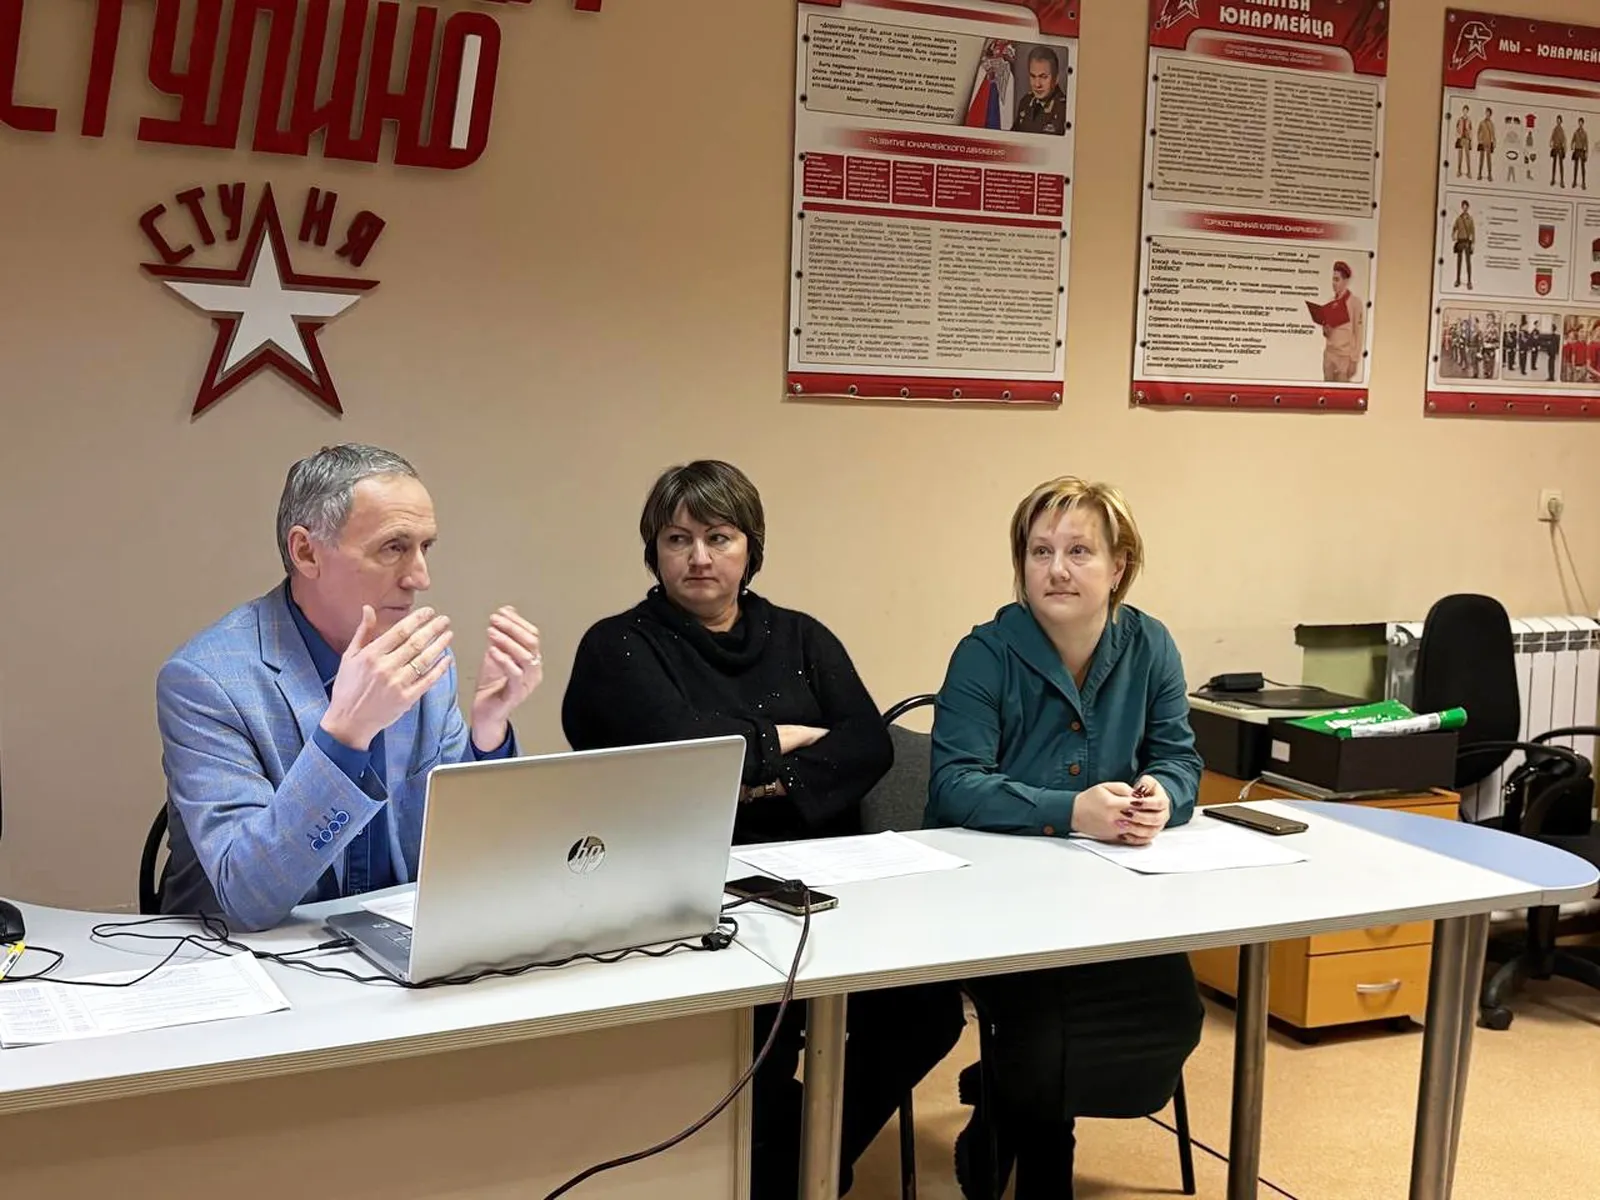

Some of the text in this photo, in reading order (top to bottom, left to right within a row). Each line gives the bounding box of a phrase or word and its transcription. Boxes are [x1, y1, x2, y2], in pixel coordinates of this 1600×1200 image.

[1219, 5, 1334, 38] ЮНАРМЕЙЦА
[1499, 39, 1520, 53] МЫ
[1537, 44, 1600, 63] ЮНАРМЕЙ
[568, 836, 604, 874] hp
